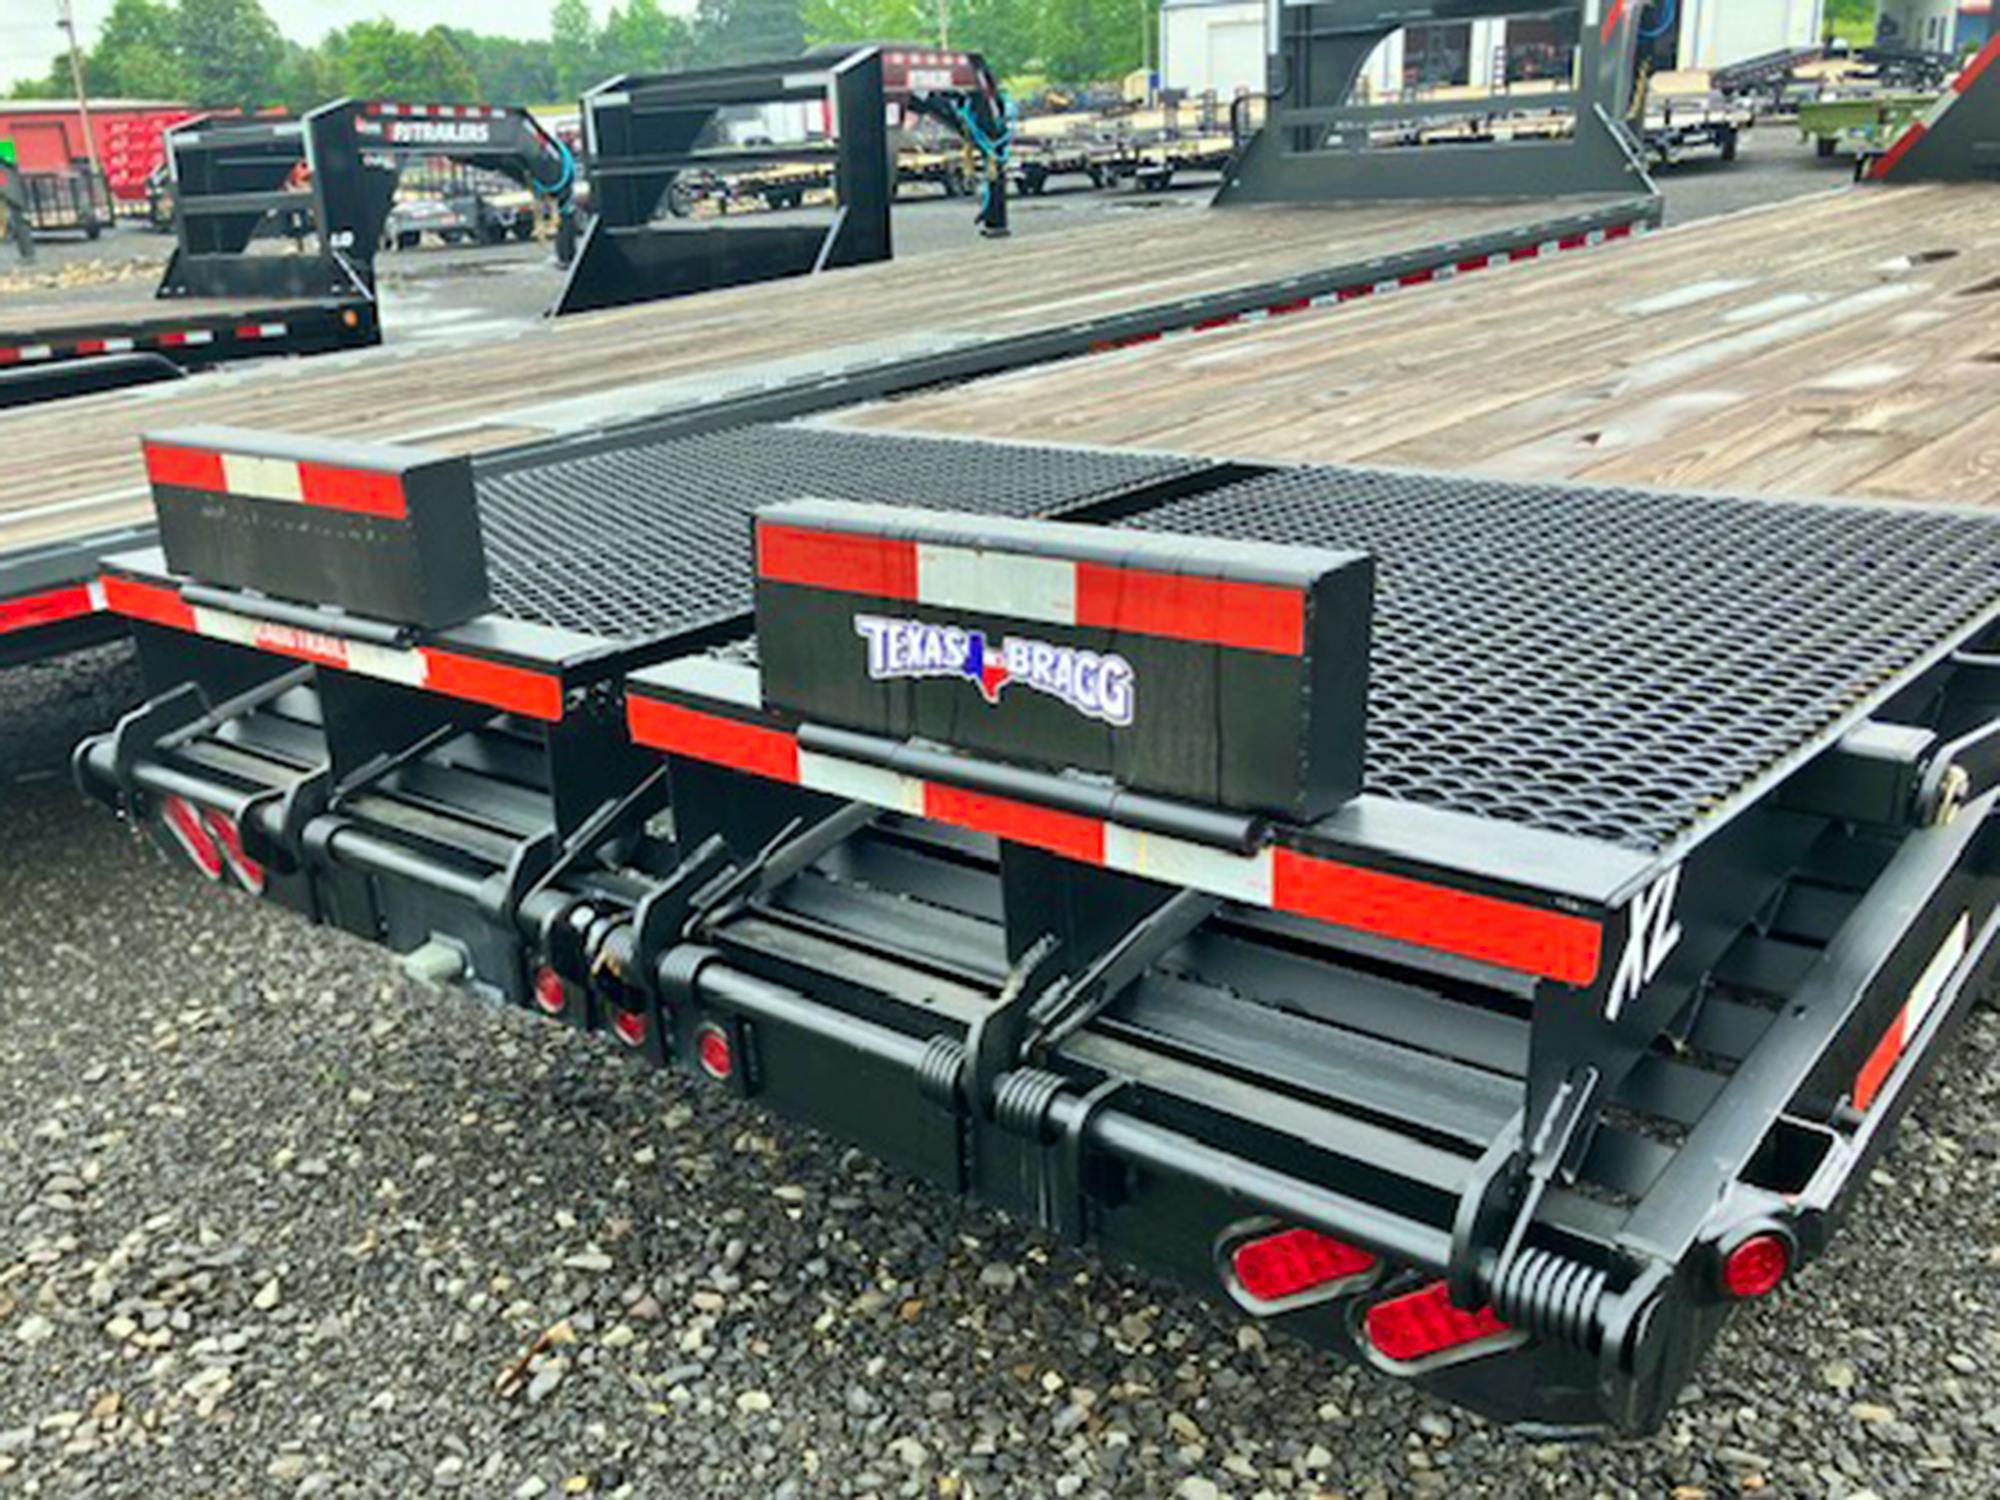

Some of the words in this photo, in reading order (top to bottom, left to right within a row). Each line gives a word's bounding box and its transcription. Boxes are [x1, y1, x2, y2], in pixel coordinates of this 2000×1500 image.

[855, 614, 970, 679] TEXAS
[1001, 635, 1135, 727] BRAGG
[1604, 861, 1684, 1023] XL
